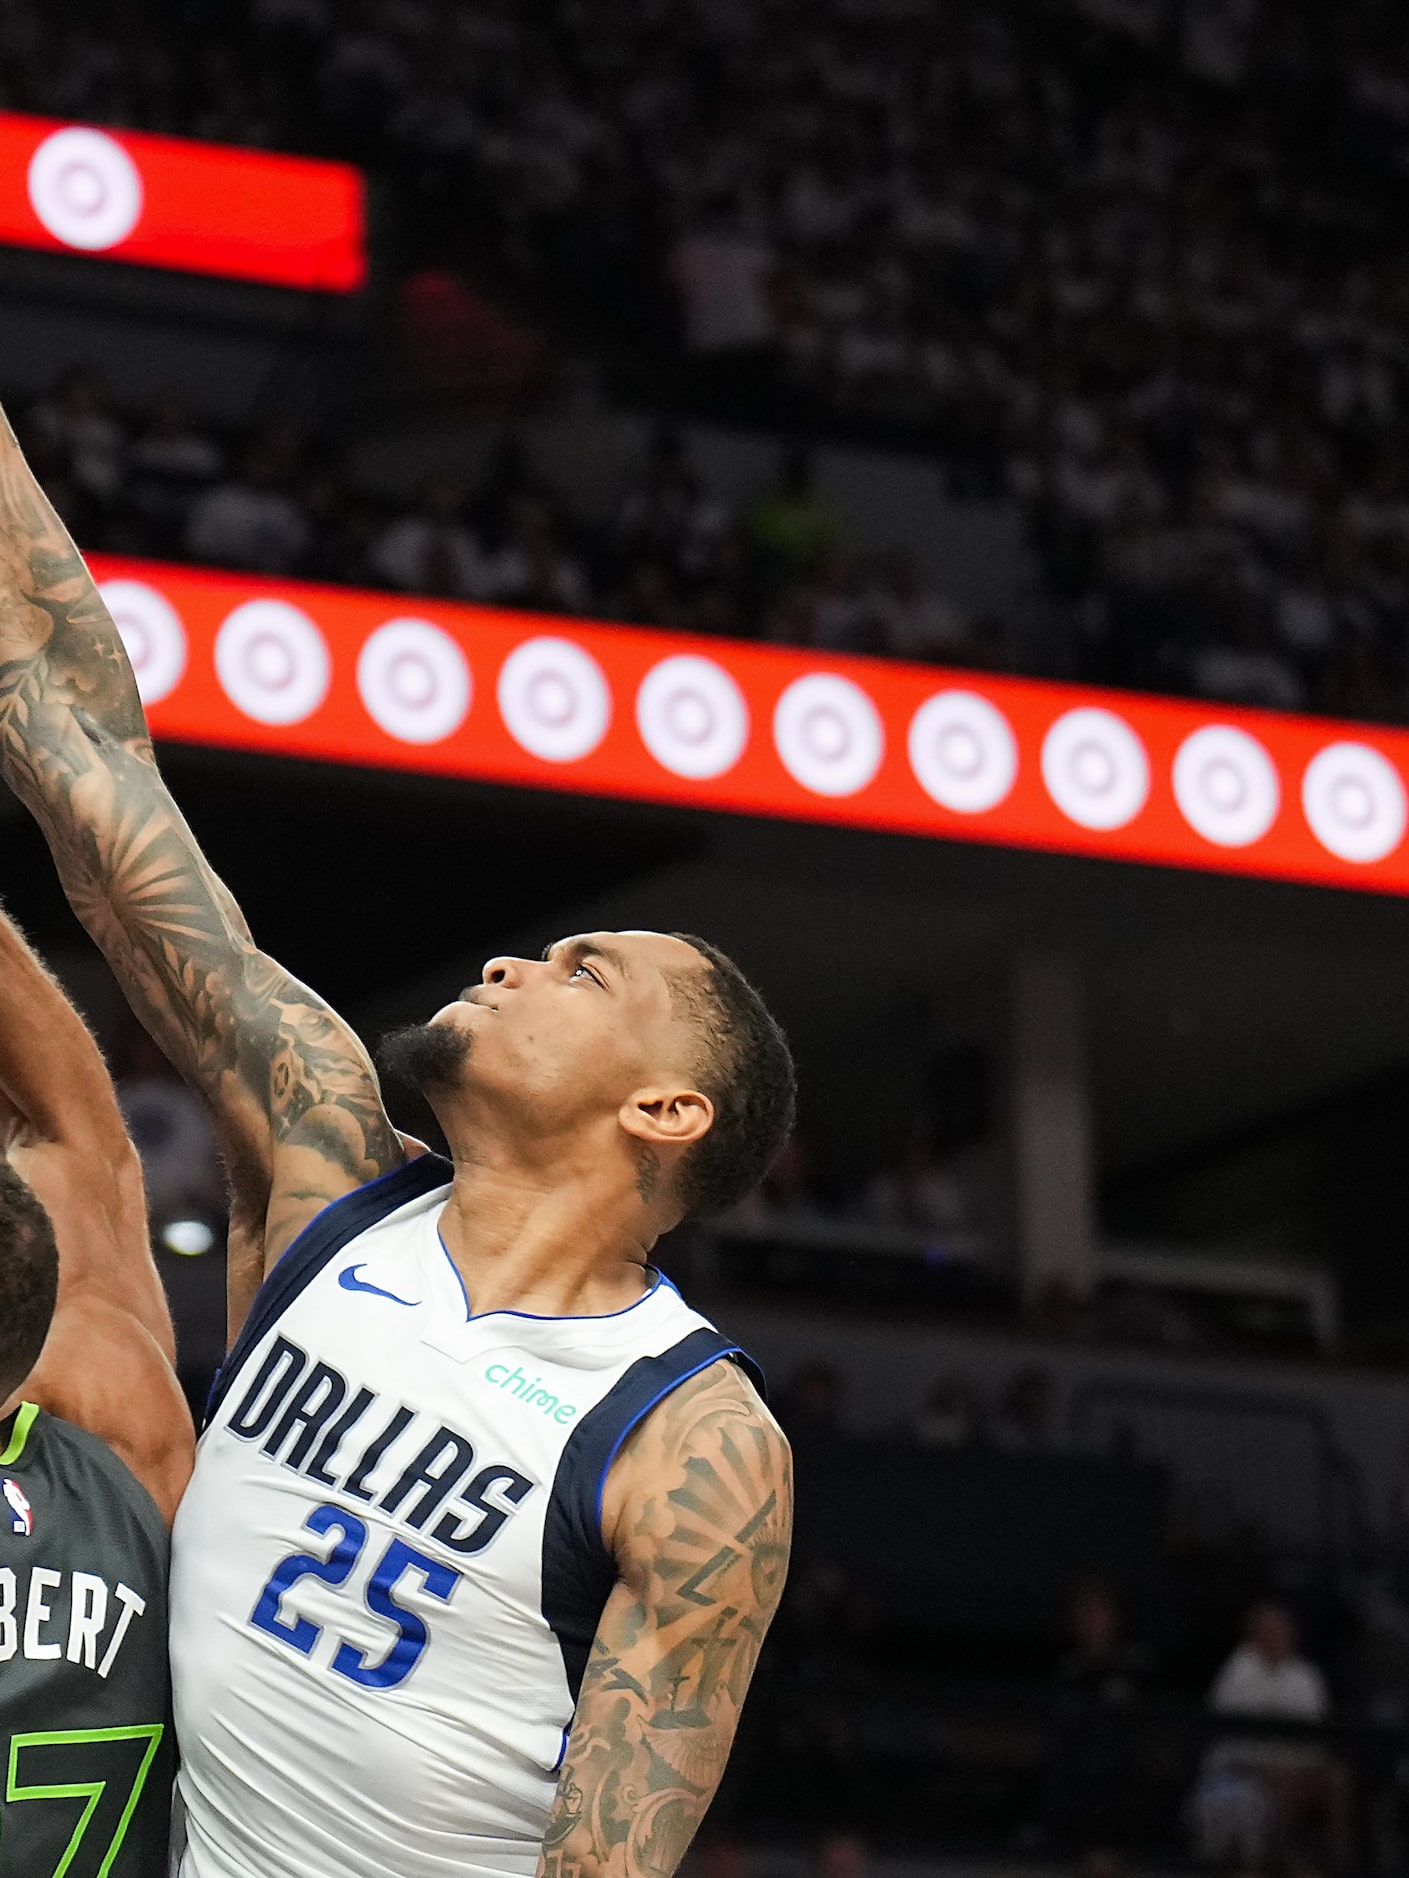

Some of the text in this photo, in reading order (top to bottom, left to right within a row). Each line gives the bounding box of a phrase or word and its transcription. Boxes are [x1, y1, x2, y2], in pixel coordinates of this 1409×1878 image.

[224, 1332, 544, 1557] DALLAS
[485, 1363, 577, 1425] chime
[247, 1502, 465, 1692] 25
